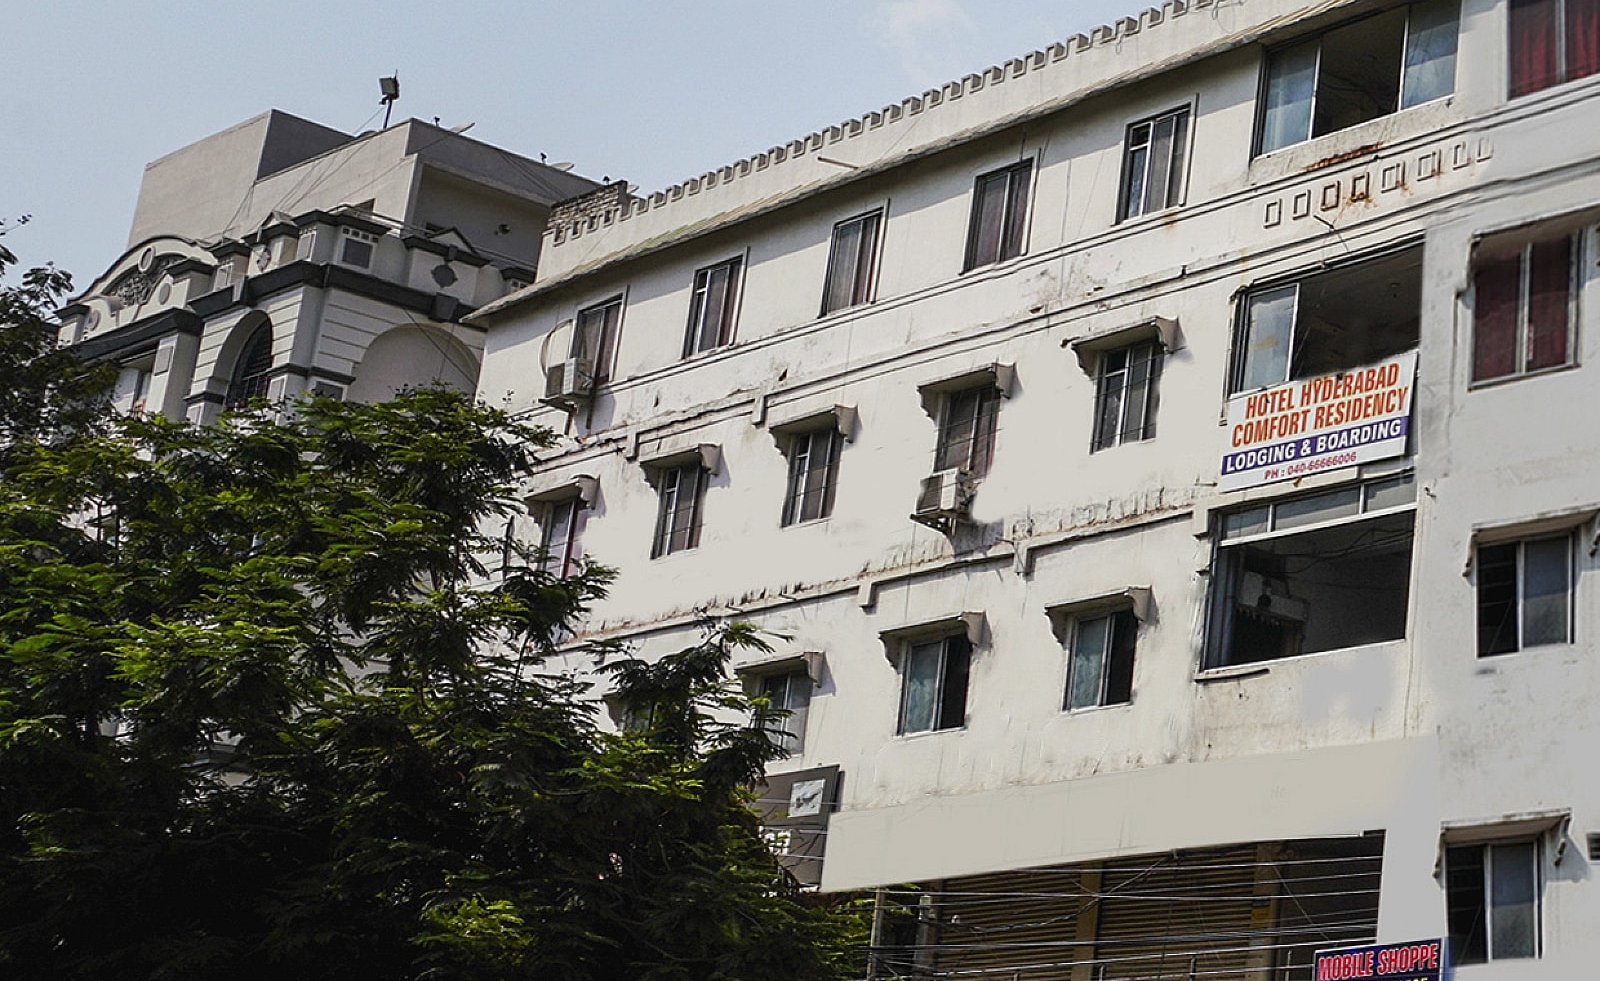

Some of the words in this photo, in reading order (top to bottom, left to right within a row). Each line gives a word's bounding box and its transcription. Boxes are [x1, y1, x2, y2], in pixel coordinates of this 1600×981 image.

[1232, 409, 1311, 448] COMFORT
[1314, 387, 1408, 429] RESIDENCY
[1245, 387, 1295, 419] HOTEL
[1300, 363, 1400, 407] HYDERABAD
[1225, 442, 1296, 473] LODGING
[1301, 440, 1312, 457] &
[1315, 419, 1401, 452] BOARDING
[1317, 951, 1374, 981] MOBILE
[1377, 943, 1439, 976] SHOPPE
